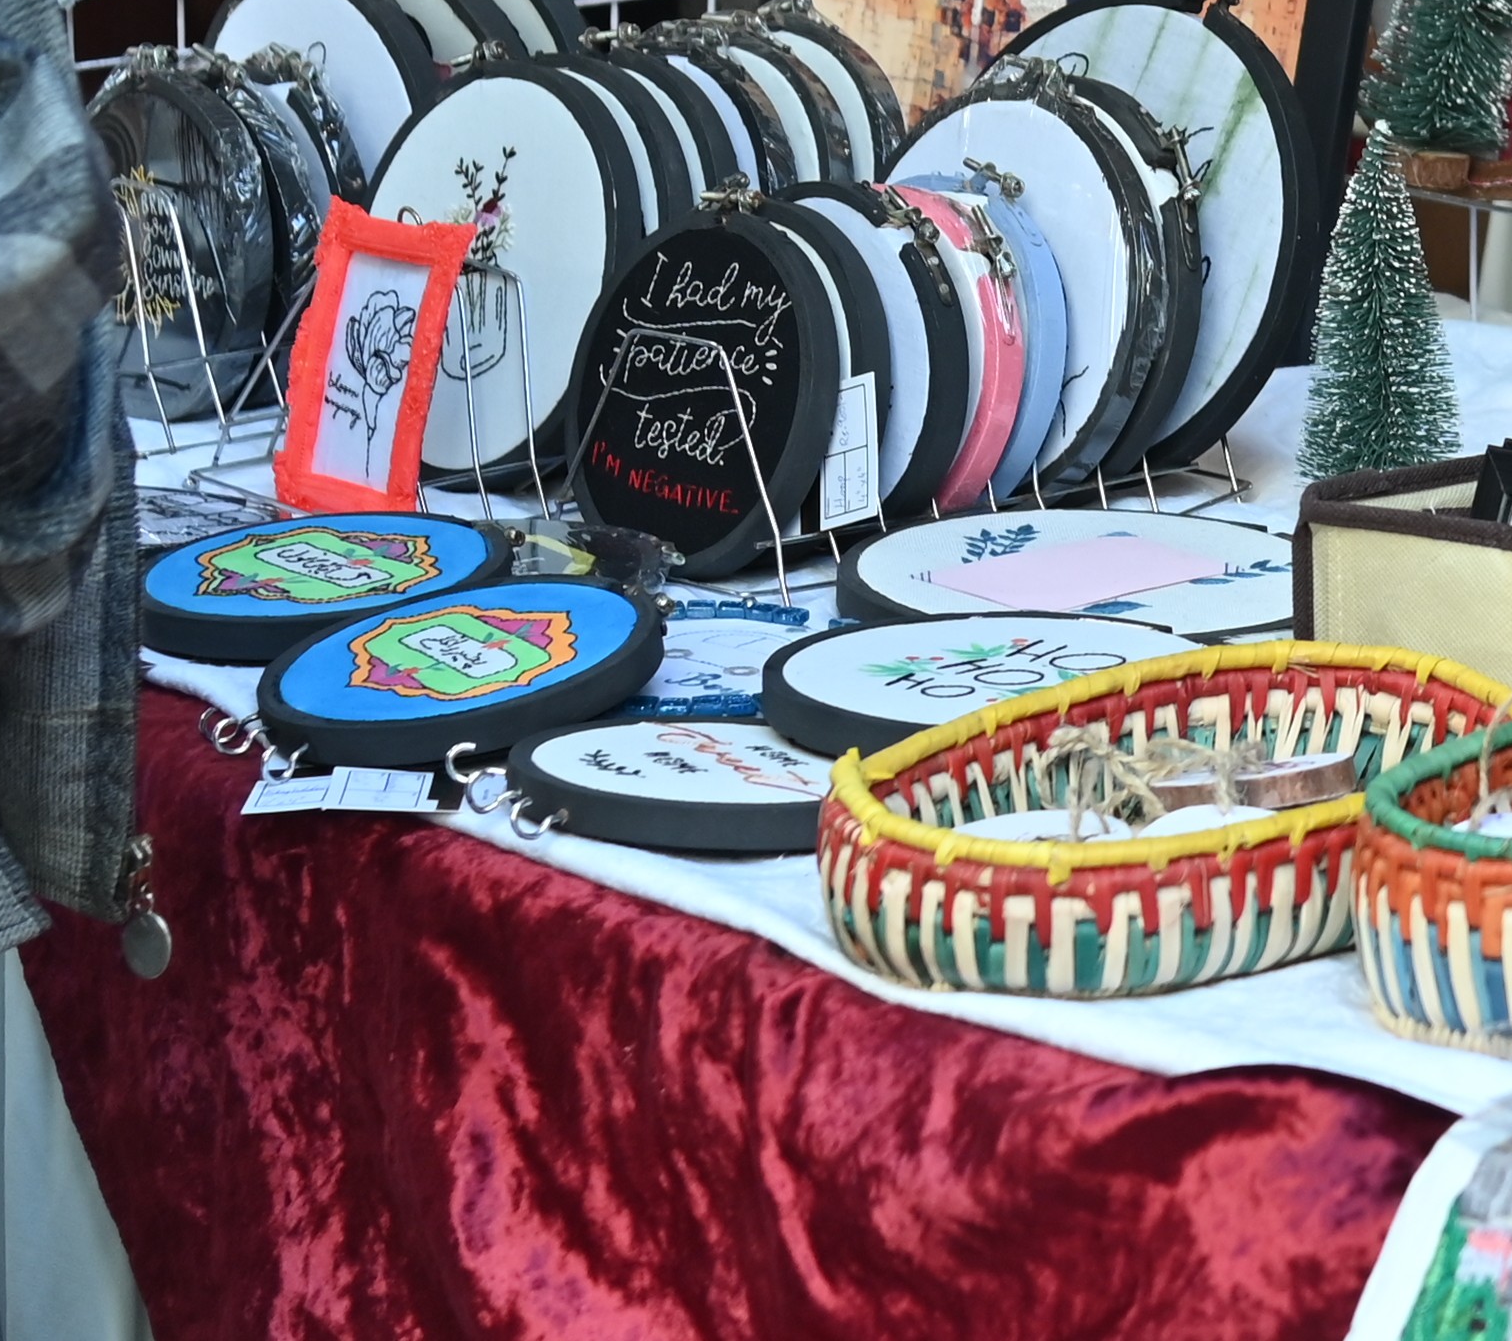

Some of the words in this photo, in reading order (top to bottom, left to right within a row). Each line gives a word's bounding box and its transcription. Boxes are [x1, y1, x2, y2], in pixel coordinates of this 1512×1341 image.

[641, 251, 669, 308] I
[665, 262, 739, 311] had
[740, 281, 792, 345] my
[623, 332, 759, 383] patience
[591, 440, 622, 478] I'M
[936, 658, 1045, 685] HO
[1005, 639, 1126, 671] HO
[884, 673, 975, 698] HO
